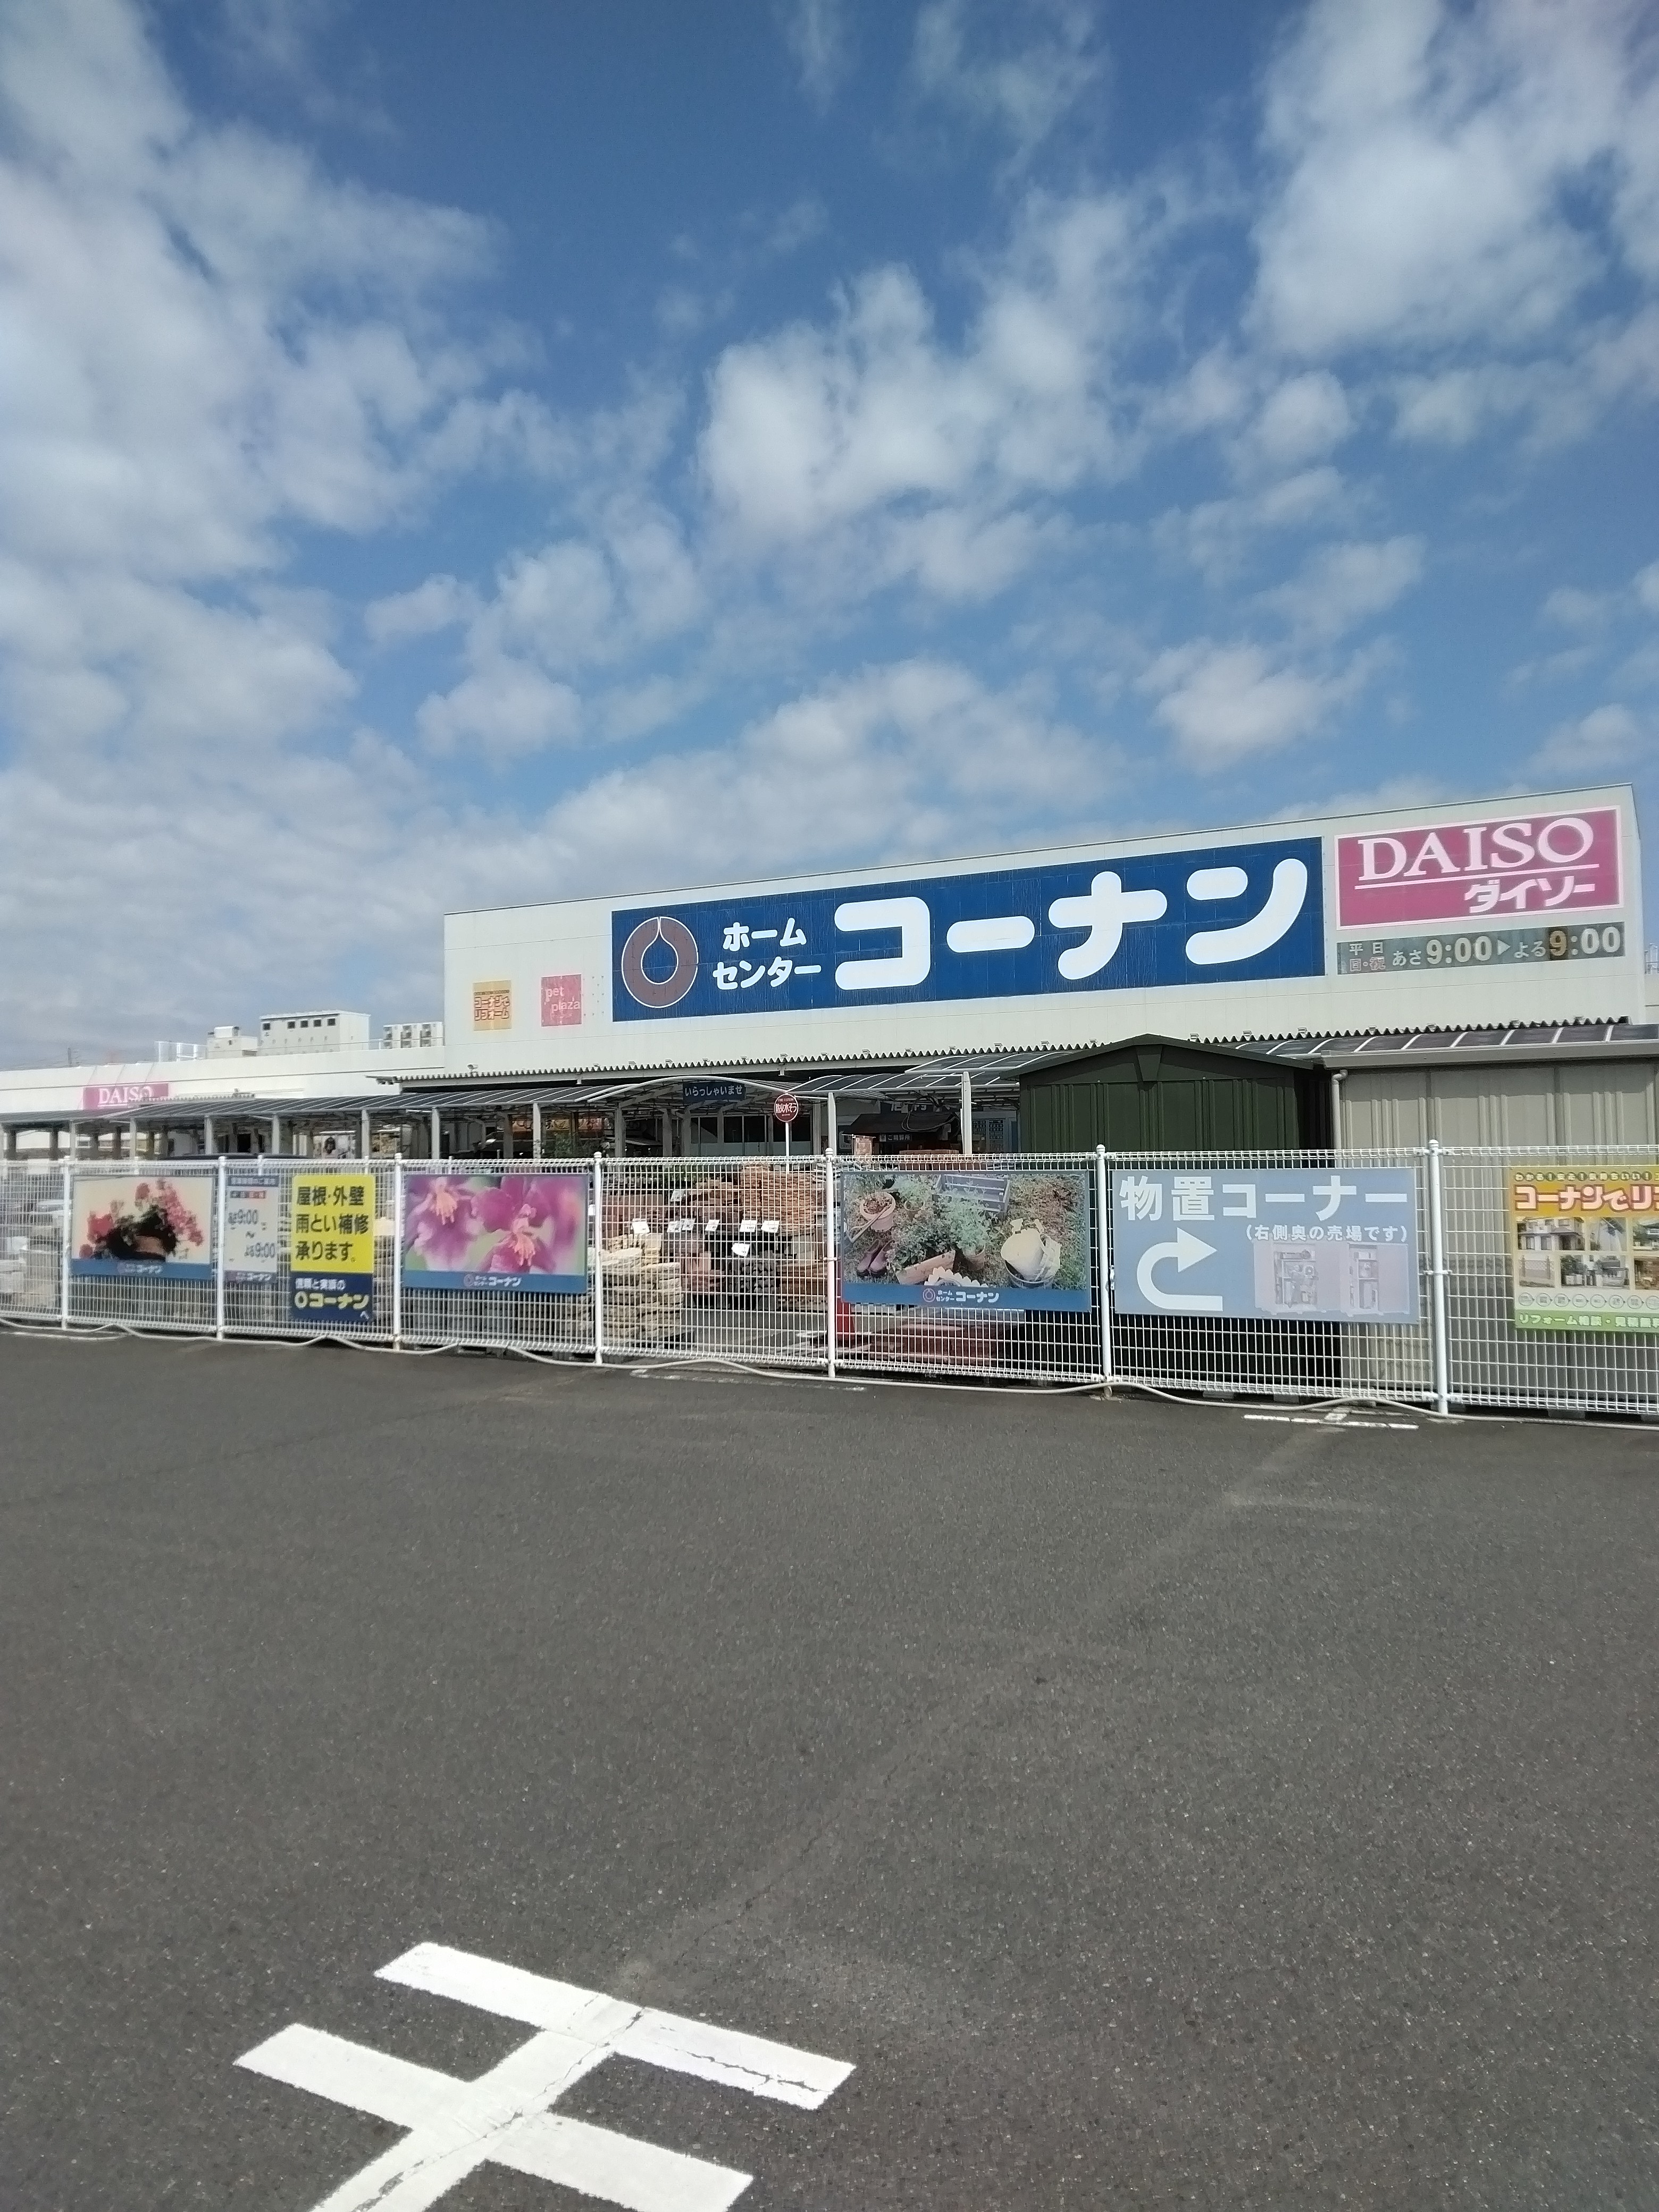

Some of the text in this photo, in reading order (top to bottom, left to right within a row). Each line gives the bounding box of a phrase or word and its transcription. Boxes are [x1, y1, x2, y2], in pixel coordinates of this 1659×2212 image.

[1357, 817, 1594, 881] DAISO
[1463, 876, 1596, 914] ダイソー
[834, 858, 1308, 991] コーナン
[723, 917, 807, 952] ホーム
[1350, 942, 1383, 956] 平日
[713, 956, 822, 991] センター
[474, 994, 510, 1008] コーナンで
[545, 986, 564, 1002] pet
[474, 1007, 509, 1021] リフォーム
[551, 1000, 581, 1013] plaza
[98, 1086, 154, 1104] DAISO
[684, 1085, 743, 1096] いらっしゃいませ
[297, 1186, 365, 1206] 屋根・外壁
[1119, 1175, 1407, 1221] 物置コーナー
[296, 1213, 369, 1235] 雨とい補修
[1246, 1224, 1407, 1243] （右側奥の売場です）
[296, 1241, 356, 1263] 承ります。
[488, 1276, 522, 1287] コーナン
[956, 1291, 999, 1303] コーナン
